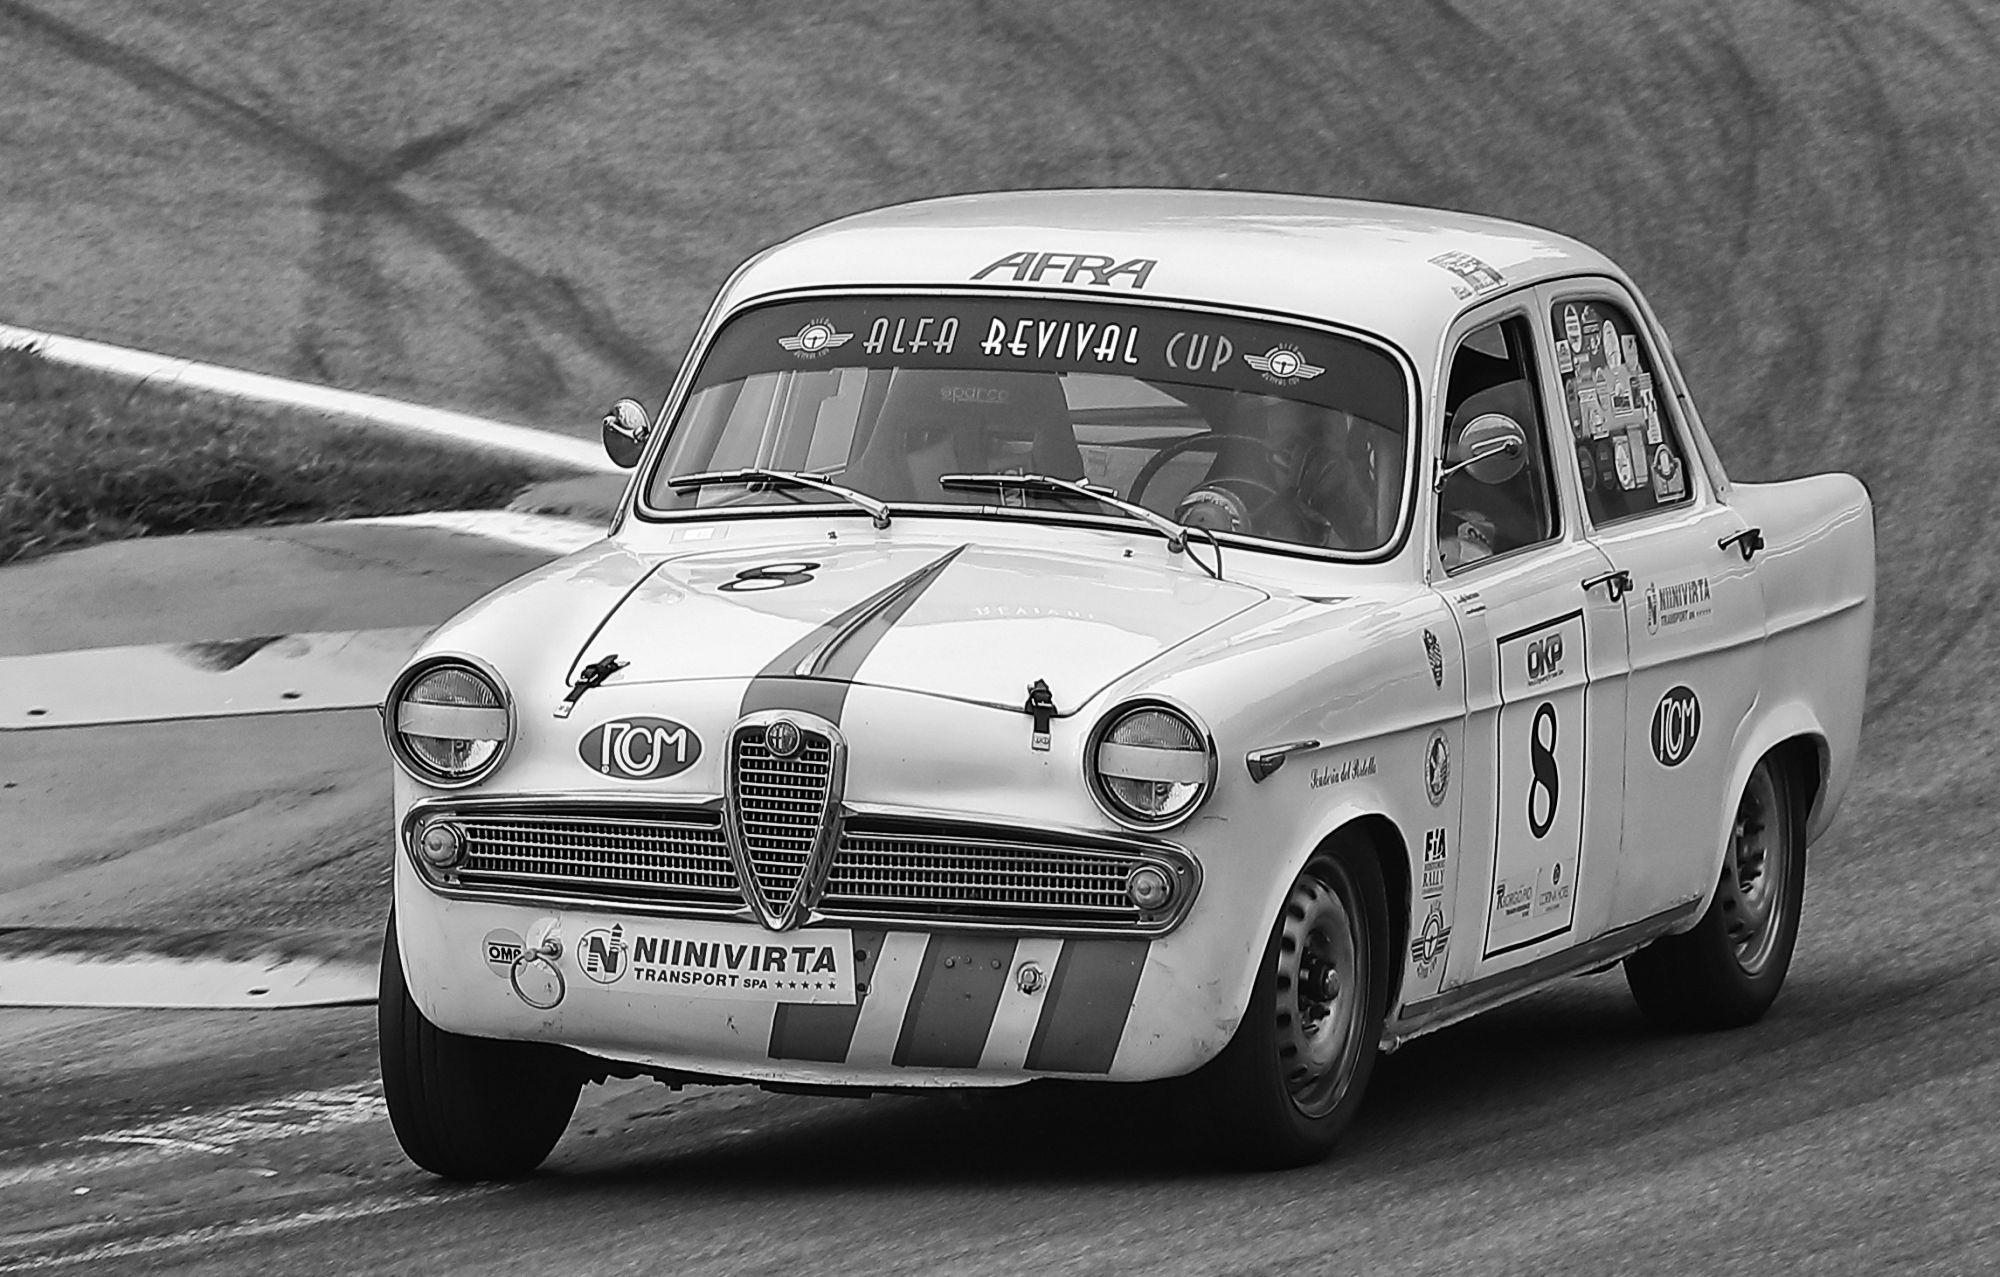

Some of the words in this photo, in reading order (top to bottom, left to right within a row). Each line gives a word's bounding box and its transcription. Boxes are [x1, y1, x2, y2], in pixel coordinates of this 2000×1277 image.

[969, 252, 1158, 289] AFRA
[863, 317, 959, 354] ALFA
[981, 318, 1138, 364] REVIVAL
[1166, 332, 1233, 372] CUP
[717, 562, 821, 592] 8
[1527, 633, 1563, 679] OKP
[1528, 701, 1559, 838] 8
[1423, 869, 1445, 887] RALLY
[489, 946, 522, 960] OMP
[634, 936, 837, 973] NIINIVIRTA
[634, 967, 740, 987] TRANSPORT
[743, 979, 768, 989] SPA
